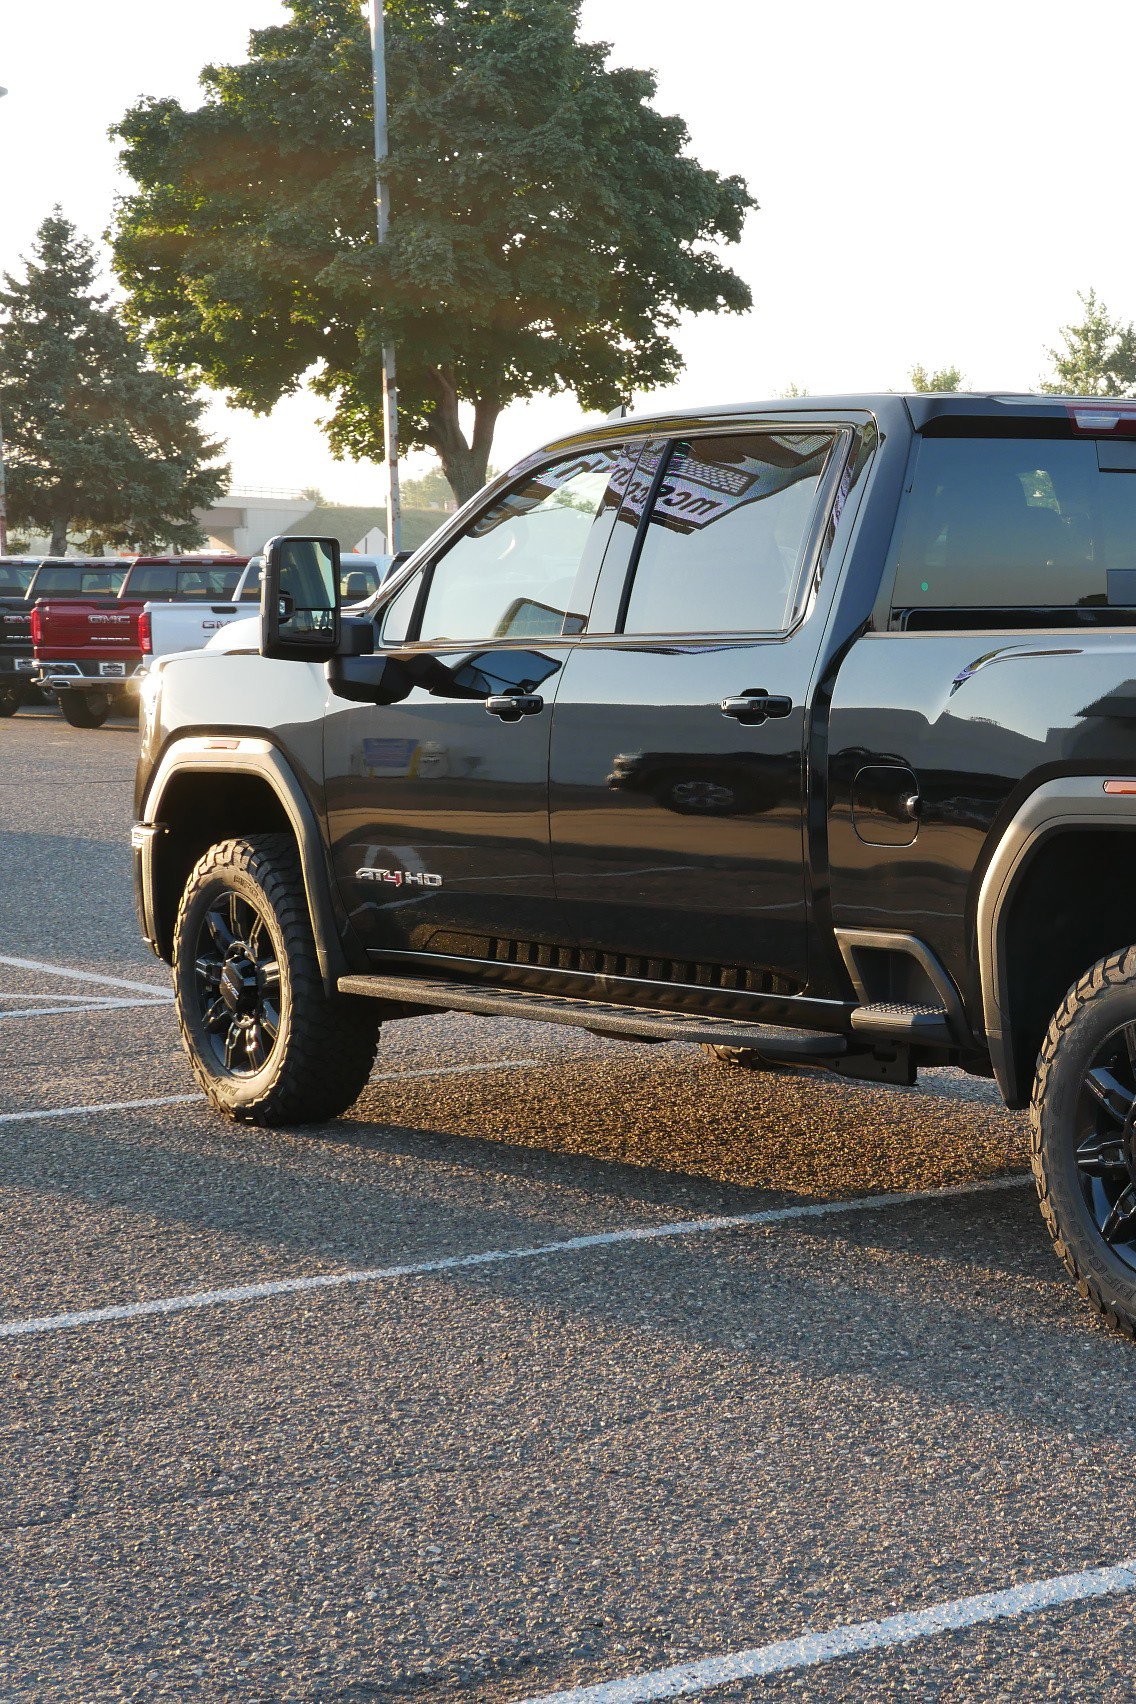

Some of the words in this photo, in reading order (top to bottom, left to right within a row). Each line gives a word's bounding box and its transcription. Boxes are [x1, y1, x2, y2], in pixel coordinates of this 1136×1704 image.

[3, 615, 32, 624] GM
[88, 614, 131, 624] GMC
[356, 867, 402, 887] AT4
[405, 871, 442, 887] HD
